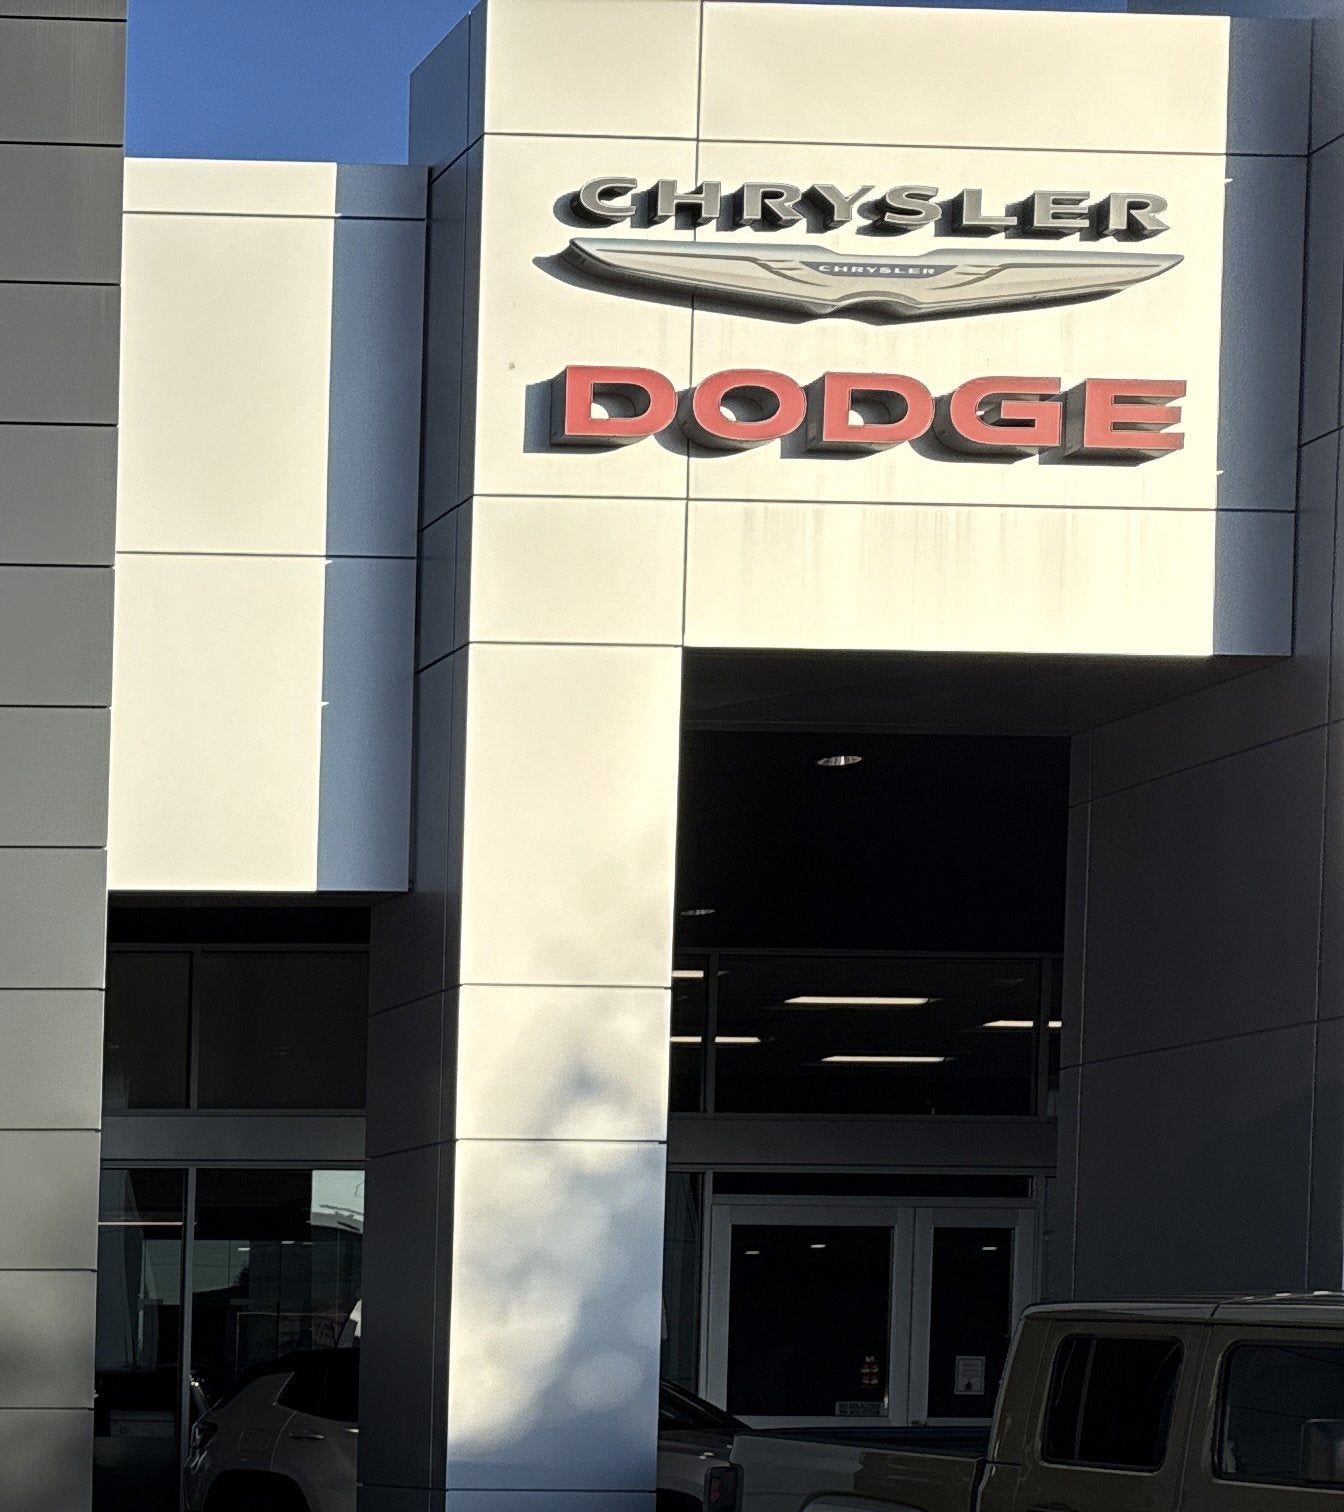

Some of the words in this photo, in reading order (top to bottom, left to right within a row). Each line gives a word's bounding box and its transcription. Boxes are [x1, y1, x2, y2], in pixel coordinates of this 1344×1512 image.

[570, 176, 1171, 234] CHRYSLER
[818, 264, 935, 275] CHRYSLER
[558, 364, 1187, 456] DODGE
